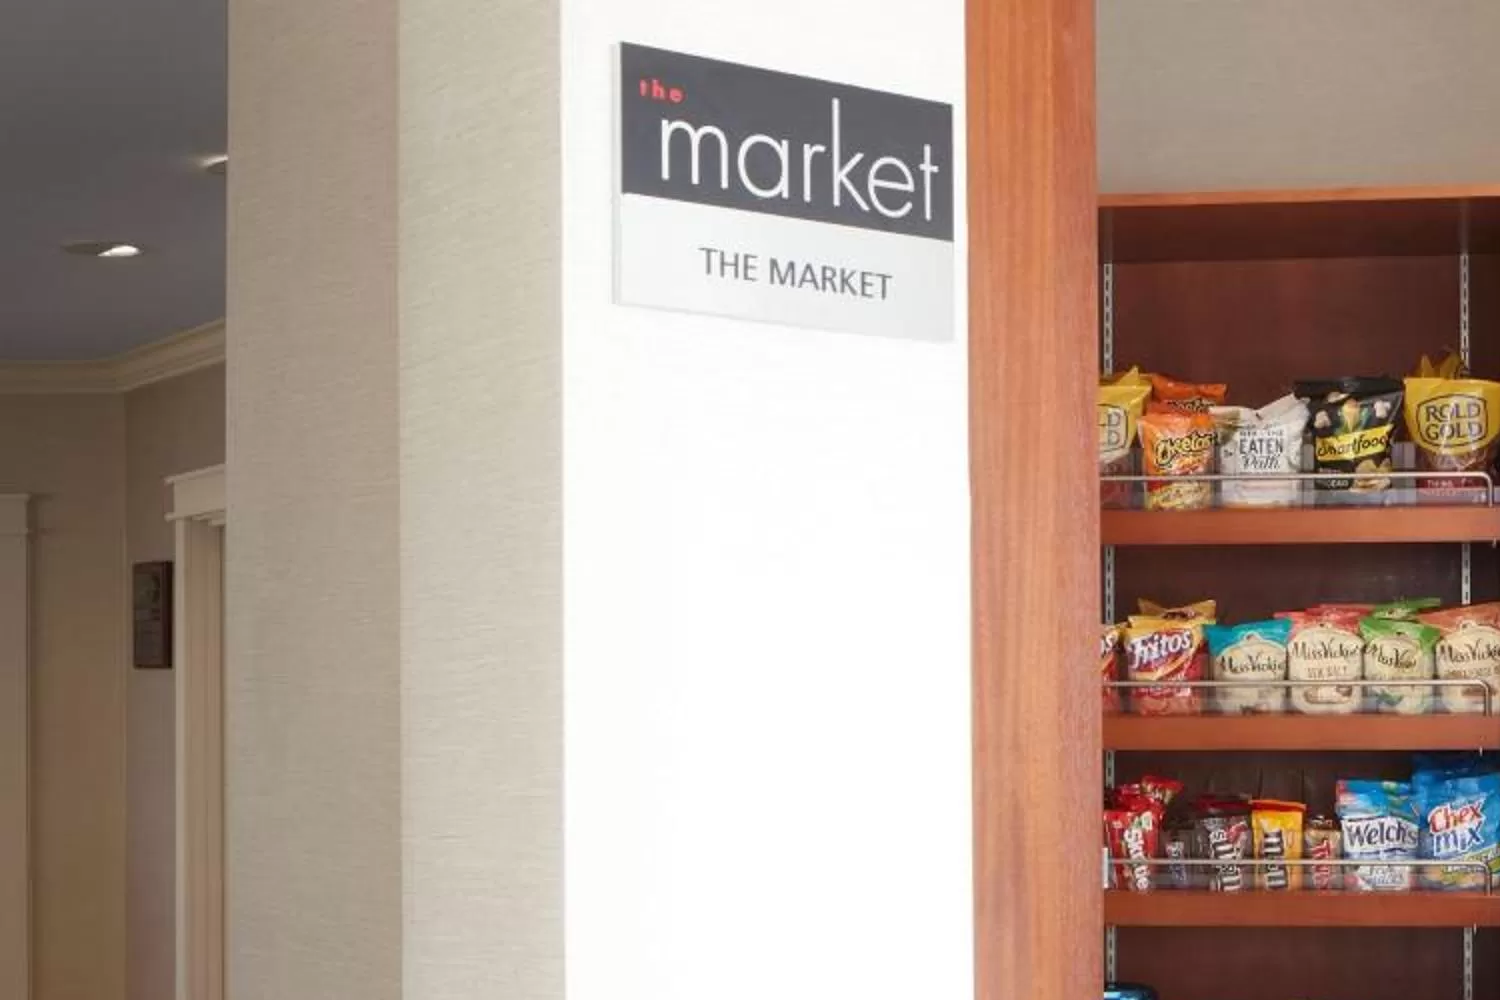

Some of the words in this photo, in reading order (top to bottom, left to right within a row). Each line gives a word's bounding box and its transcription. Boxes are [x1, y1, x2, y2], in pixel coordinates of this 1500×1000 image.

[640, 79, 685, 103] the
[661, 97, 939, 221] market
[698, 247, 758, 282] THE
[769, 257, 893, 301] MARKET
[1425, 400, 1481, 423] ROLD
[1425, 423, 1482, 442] GOLD
[1239, 437, 1284, 456] EATEN
[1429, 803, 1483, 834] Chex
[1349, 820, 1419, 848] Welch's
